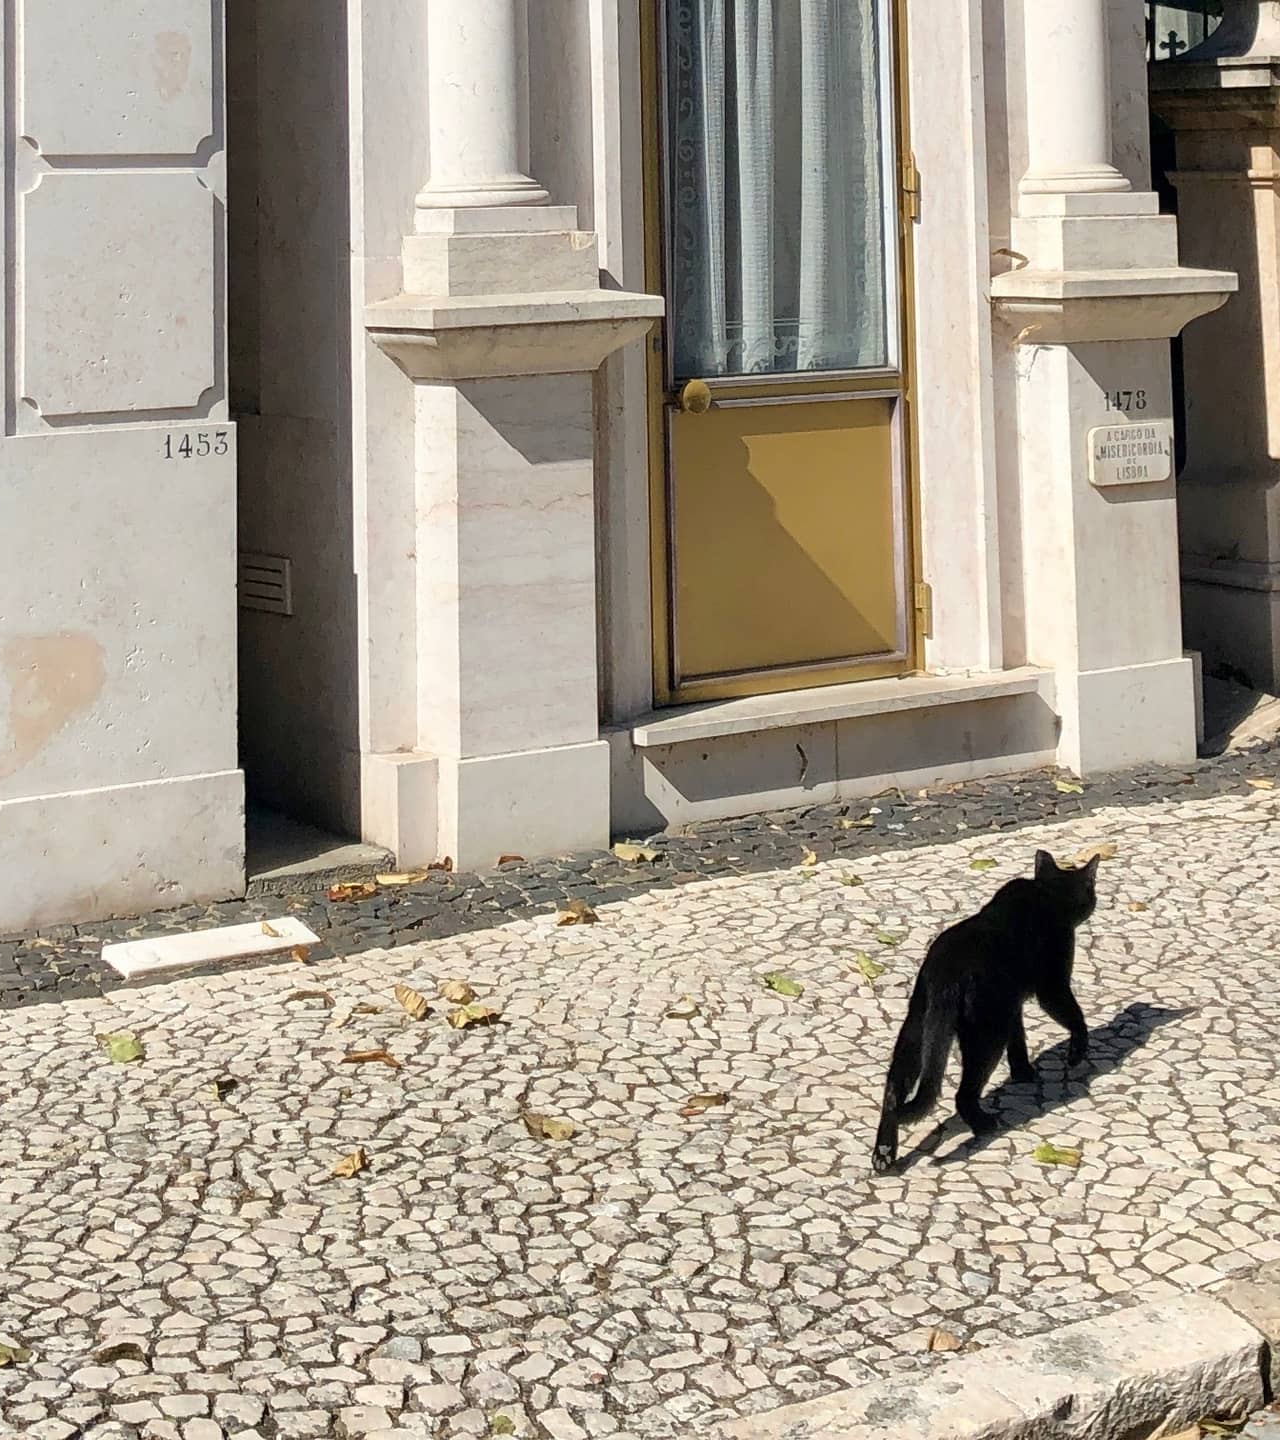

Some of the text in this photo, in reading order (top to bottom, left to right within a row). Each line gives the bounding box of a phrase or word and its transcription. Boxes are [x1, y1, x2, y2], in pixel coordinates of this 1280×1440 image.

[1103, 390, 1147, 411] 1478
[163, 431, 229, 459] 1453
[1106, 431, 1112, 441] A
[1117, 465, 1148, 480] LISBOA
